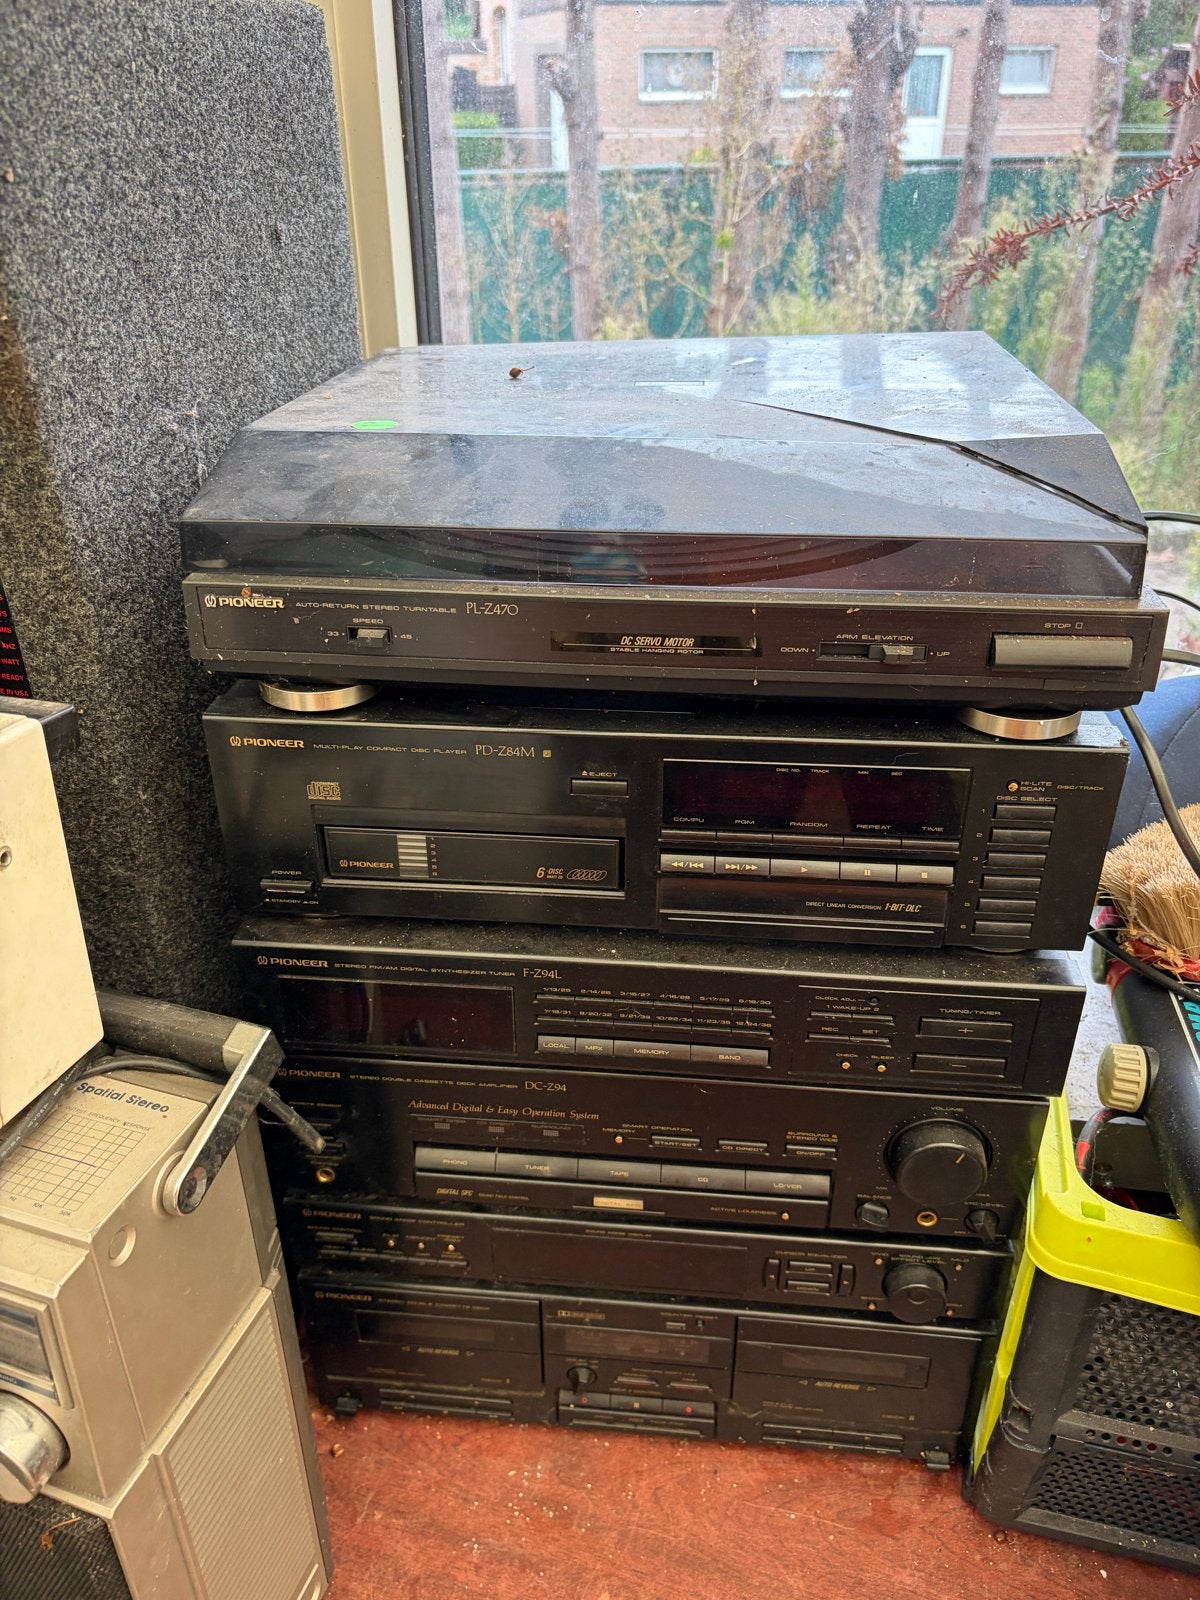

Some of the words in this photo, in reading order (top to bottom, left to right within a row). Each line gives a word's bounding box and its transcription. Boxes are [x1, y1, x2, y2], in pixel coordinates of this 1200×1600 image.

[218, 596, 284, 608] PIONEER
[296, 602, 360, 610] AUTO-RETURN
[403, 606, 457, 614] TURNTABLE
[466, 602, 519, 616] PL-Z470
[620, 636, 632, 646] DC
[634, 636, 662, 647] SERVO
[664, 637, 695, 648] MOTOR
[244, 738, 304, 748] PIONEER
[475, 744, 536, 758] PD-Z84M
[350, 860, 394, 869] PIONEER
[536, 867, 546, 878] 6
[270, 957, 329, 968] PIONEER
[522, 968, 562, 980] F-Z94L
[939, 1008, 1002, 1016] TUNING/TIMER
[634, 1048, 670, 1056] MEMORY
[289, 1069, 341, 1079] PIONEER
[524, 1081, 567, 1092] DC-Z94
[76, 1082, 126, 1101] Spatial
[126, 1094, 170, 1113] Stereo
[408, 1100, 449, 1112] Advanced
[452, 1102, 483, 1114] Digital
[486, 1104, 494, 1114] &
[497, 1104, 519, 1118] Easy
[522, 1106, 567, 1120] Operation
[569, 1109, 600, 1122] System
